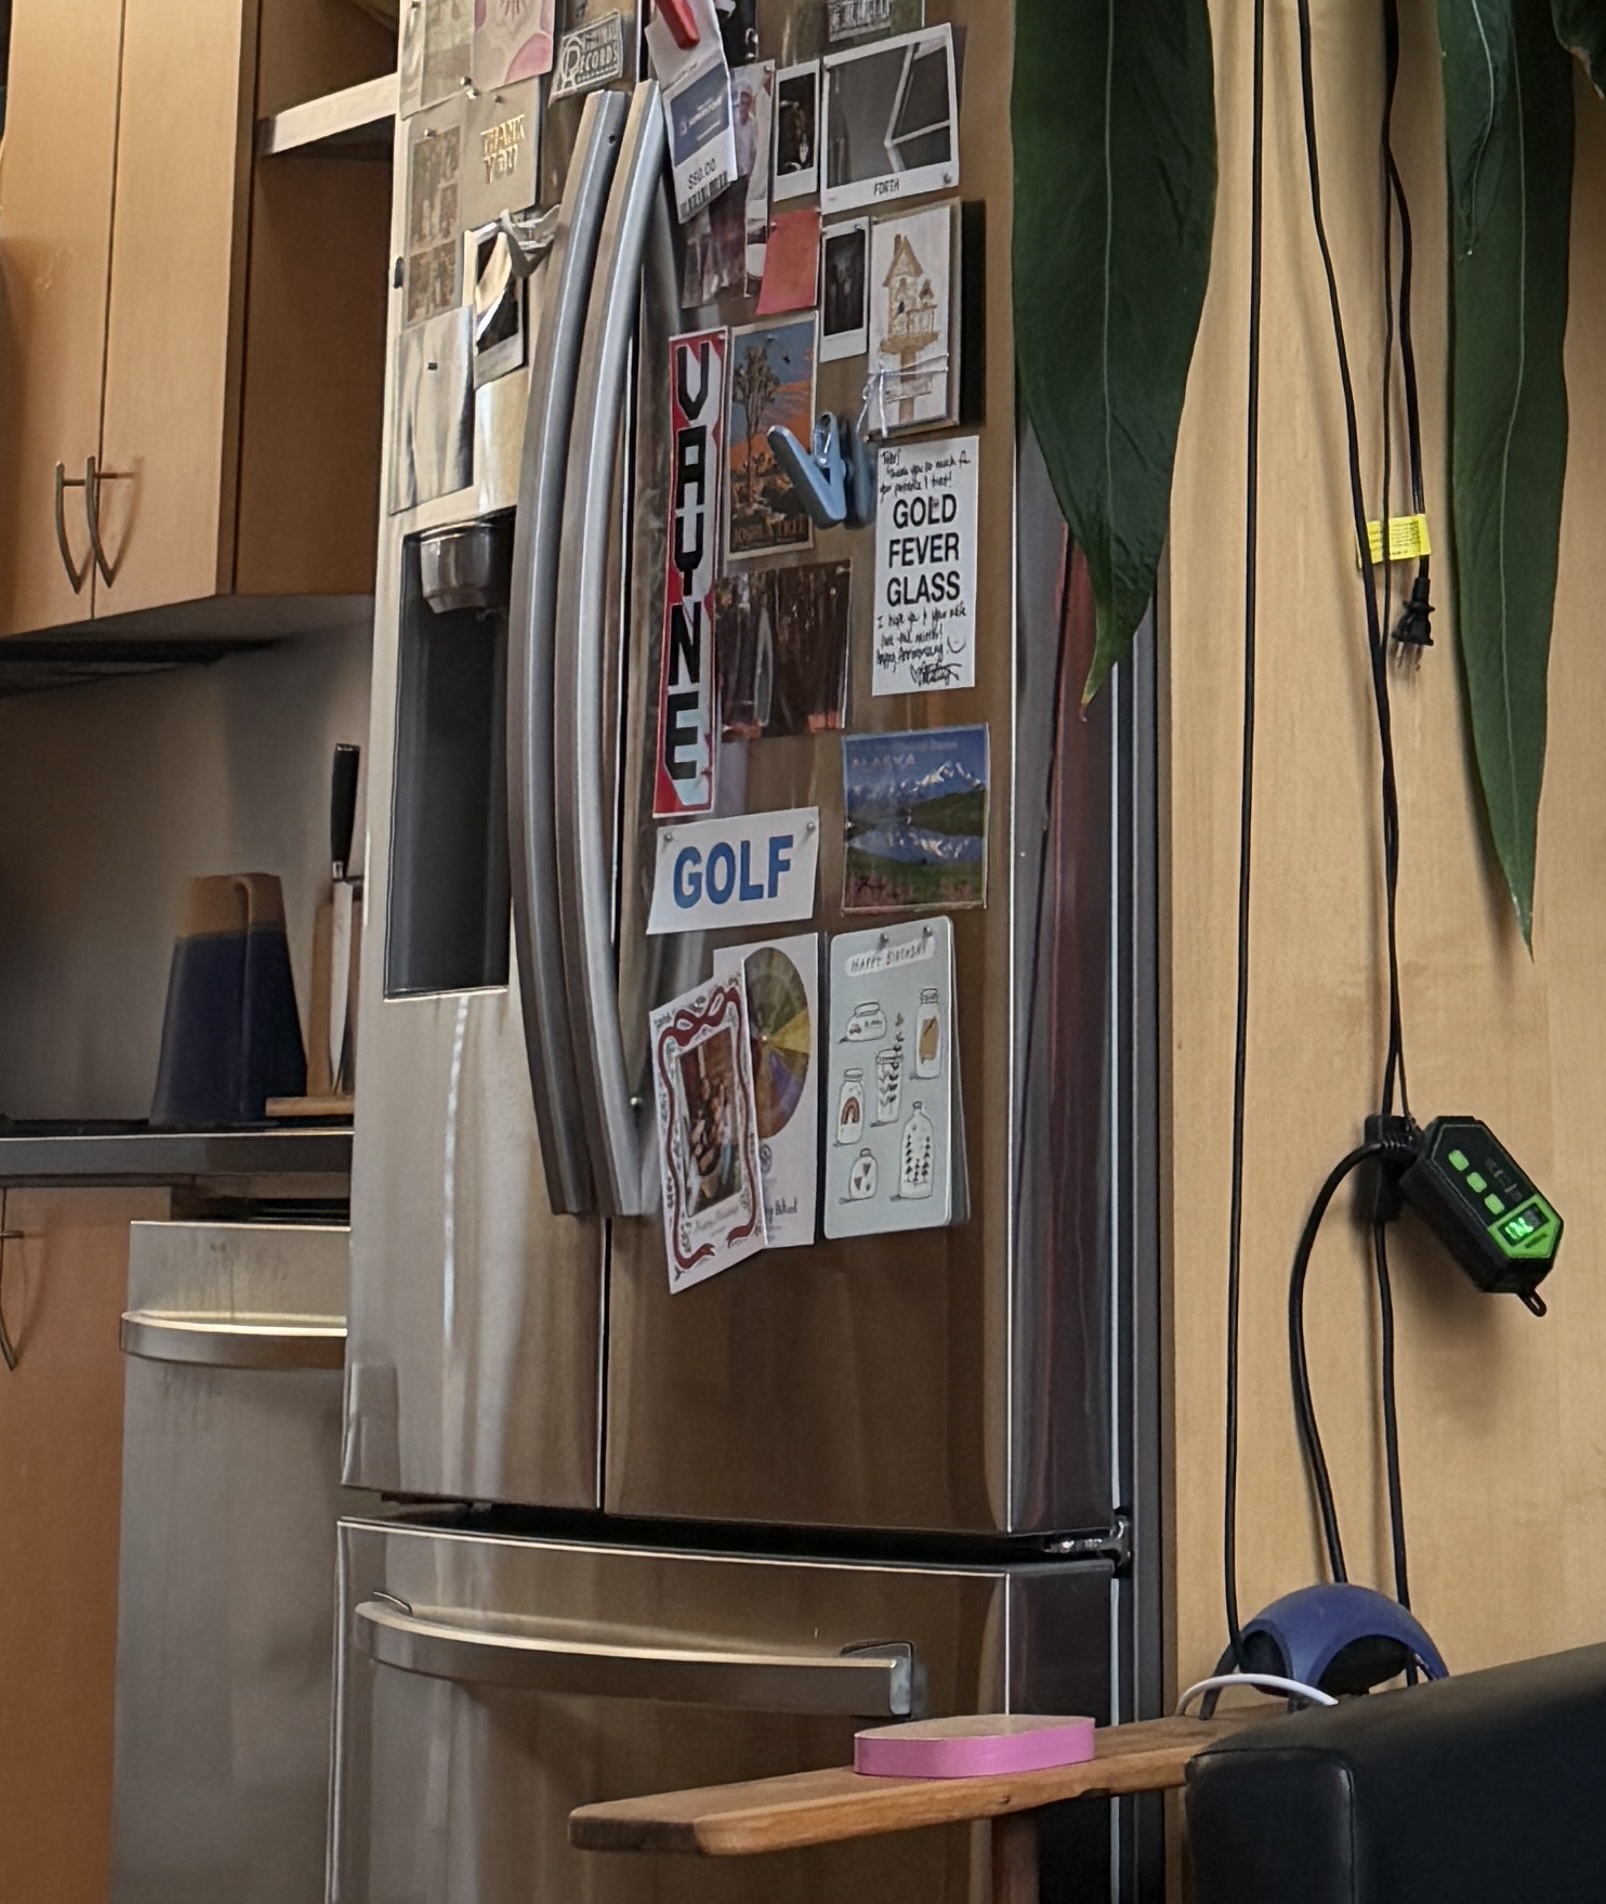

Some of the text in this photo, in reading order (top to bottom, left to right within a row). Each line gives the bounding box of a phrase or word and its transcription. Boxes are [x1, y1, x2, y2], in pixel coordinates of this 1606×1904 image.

[893, 493, 957, 529] GOLD
[889, 532, 960, 568] FEVER
[887, 570, 960, 607] GLASS
[673, 834, 794, 909] GOLF
[851, 956, 882, 972] HAPPY
